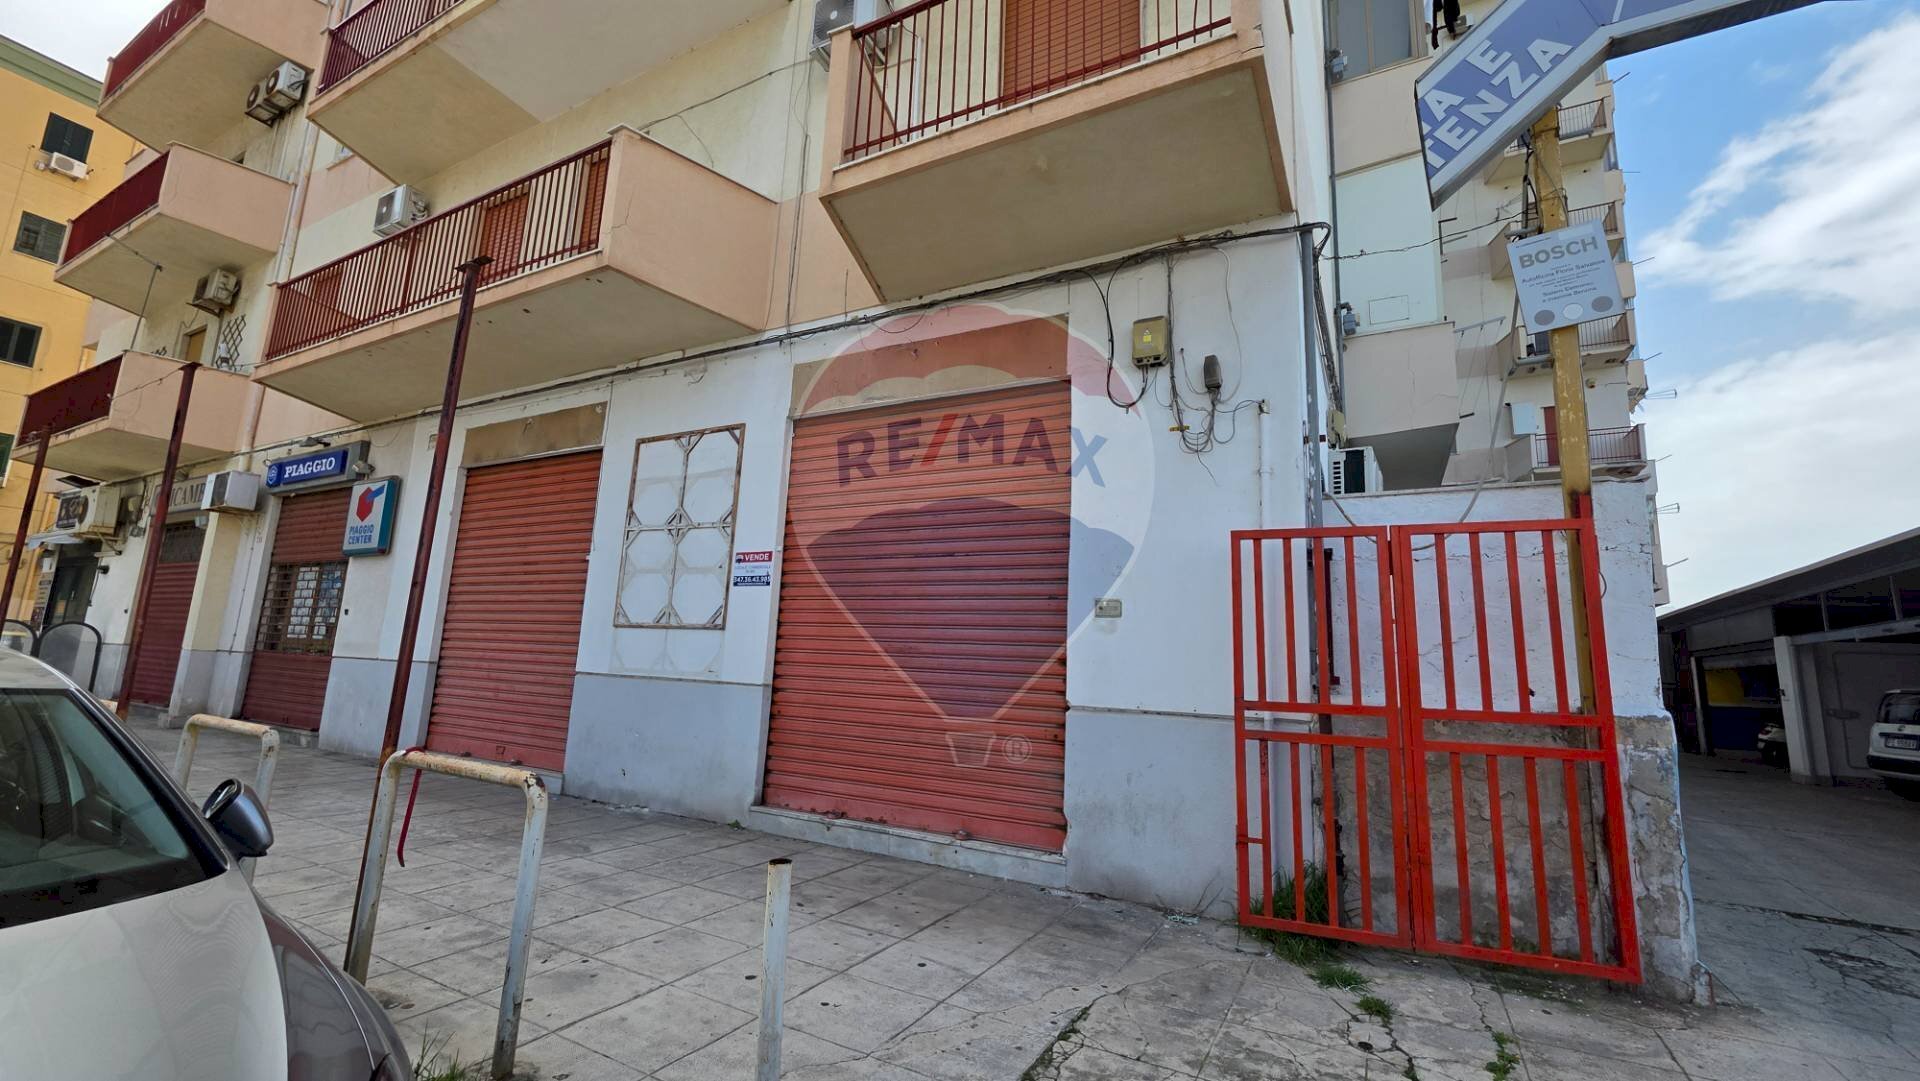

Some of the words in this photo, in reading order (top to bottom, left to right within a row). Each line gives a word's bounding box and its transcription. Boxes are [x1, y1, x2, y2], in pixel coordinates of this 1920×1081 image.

[1422, 88, 1465, 135] A
[1466, 39, 1512, 75] E
[1519, 236, 1599, 269] BOSCH
[283, 457, 336, 478] PIAGGIO
[349, 523, 375, 536] PIAGGIO
[348, 534, 373, 545] CENTER
[744, 553, 770, 561] VENDE
